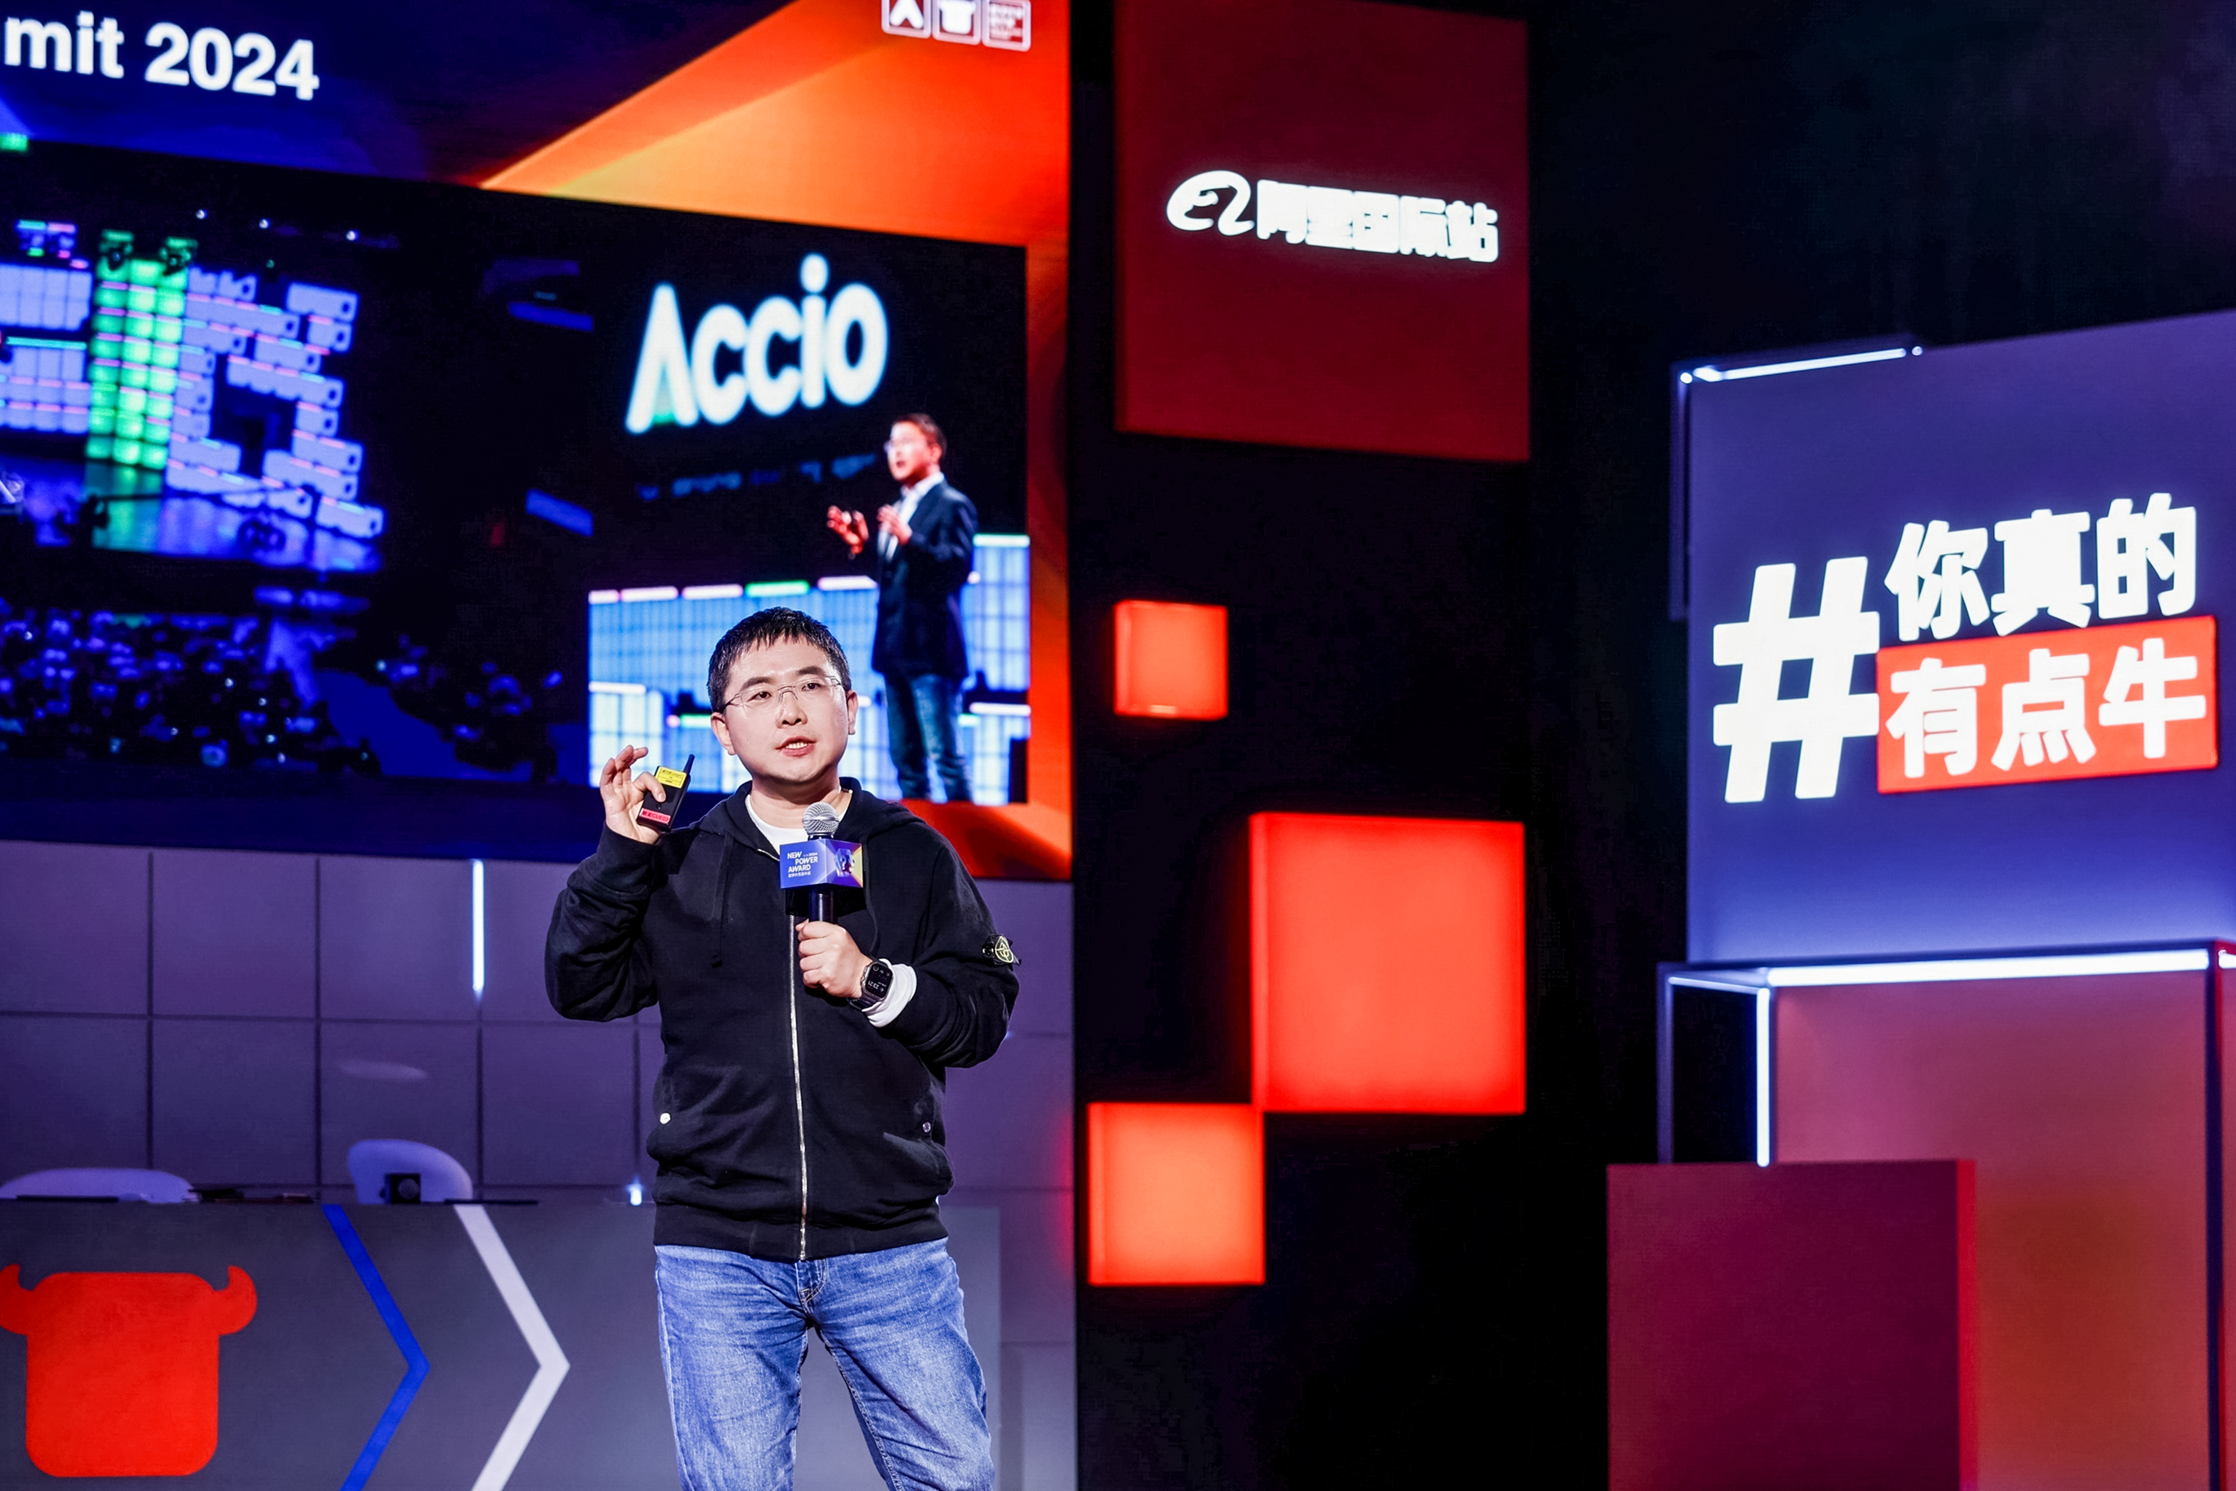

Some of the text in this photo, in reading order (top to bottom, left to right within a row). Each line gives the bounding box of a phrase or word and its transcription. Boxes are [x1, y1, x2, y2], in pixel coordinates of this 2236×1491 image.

[145, 22, 320, 101] 2024
[625, 252, 888, 435] Accio
[1884, 492, 2197, 642] 你真的
[1885, 637, 2208, 779] 有点牛
[787, 851, 802, 859] NEW
[788, 864, 811, 873] AWARD
[795, 856, 818, 865] POWER
